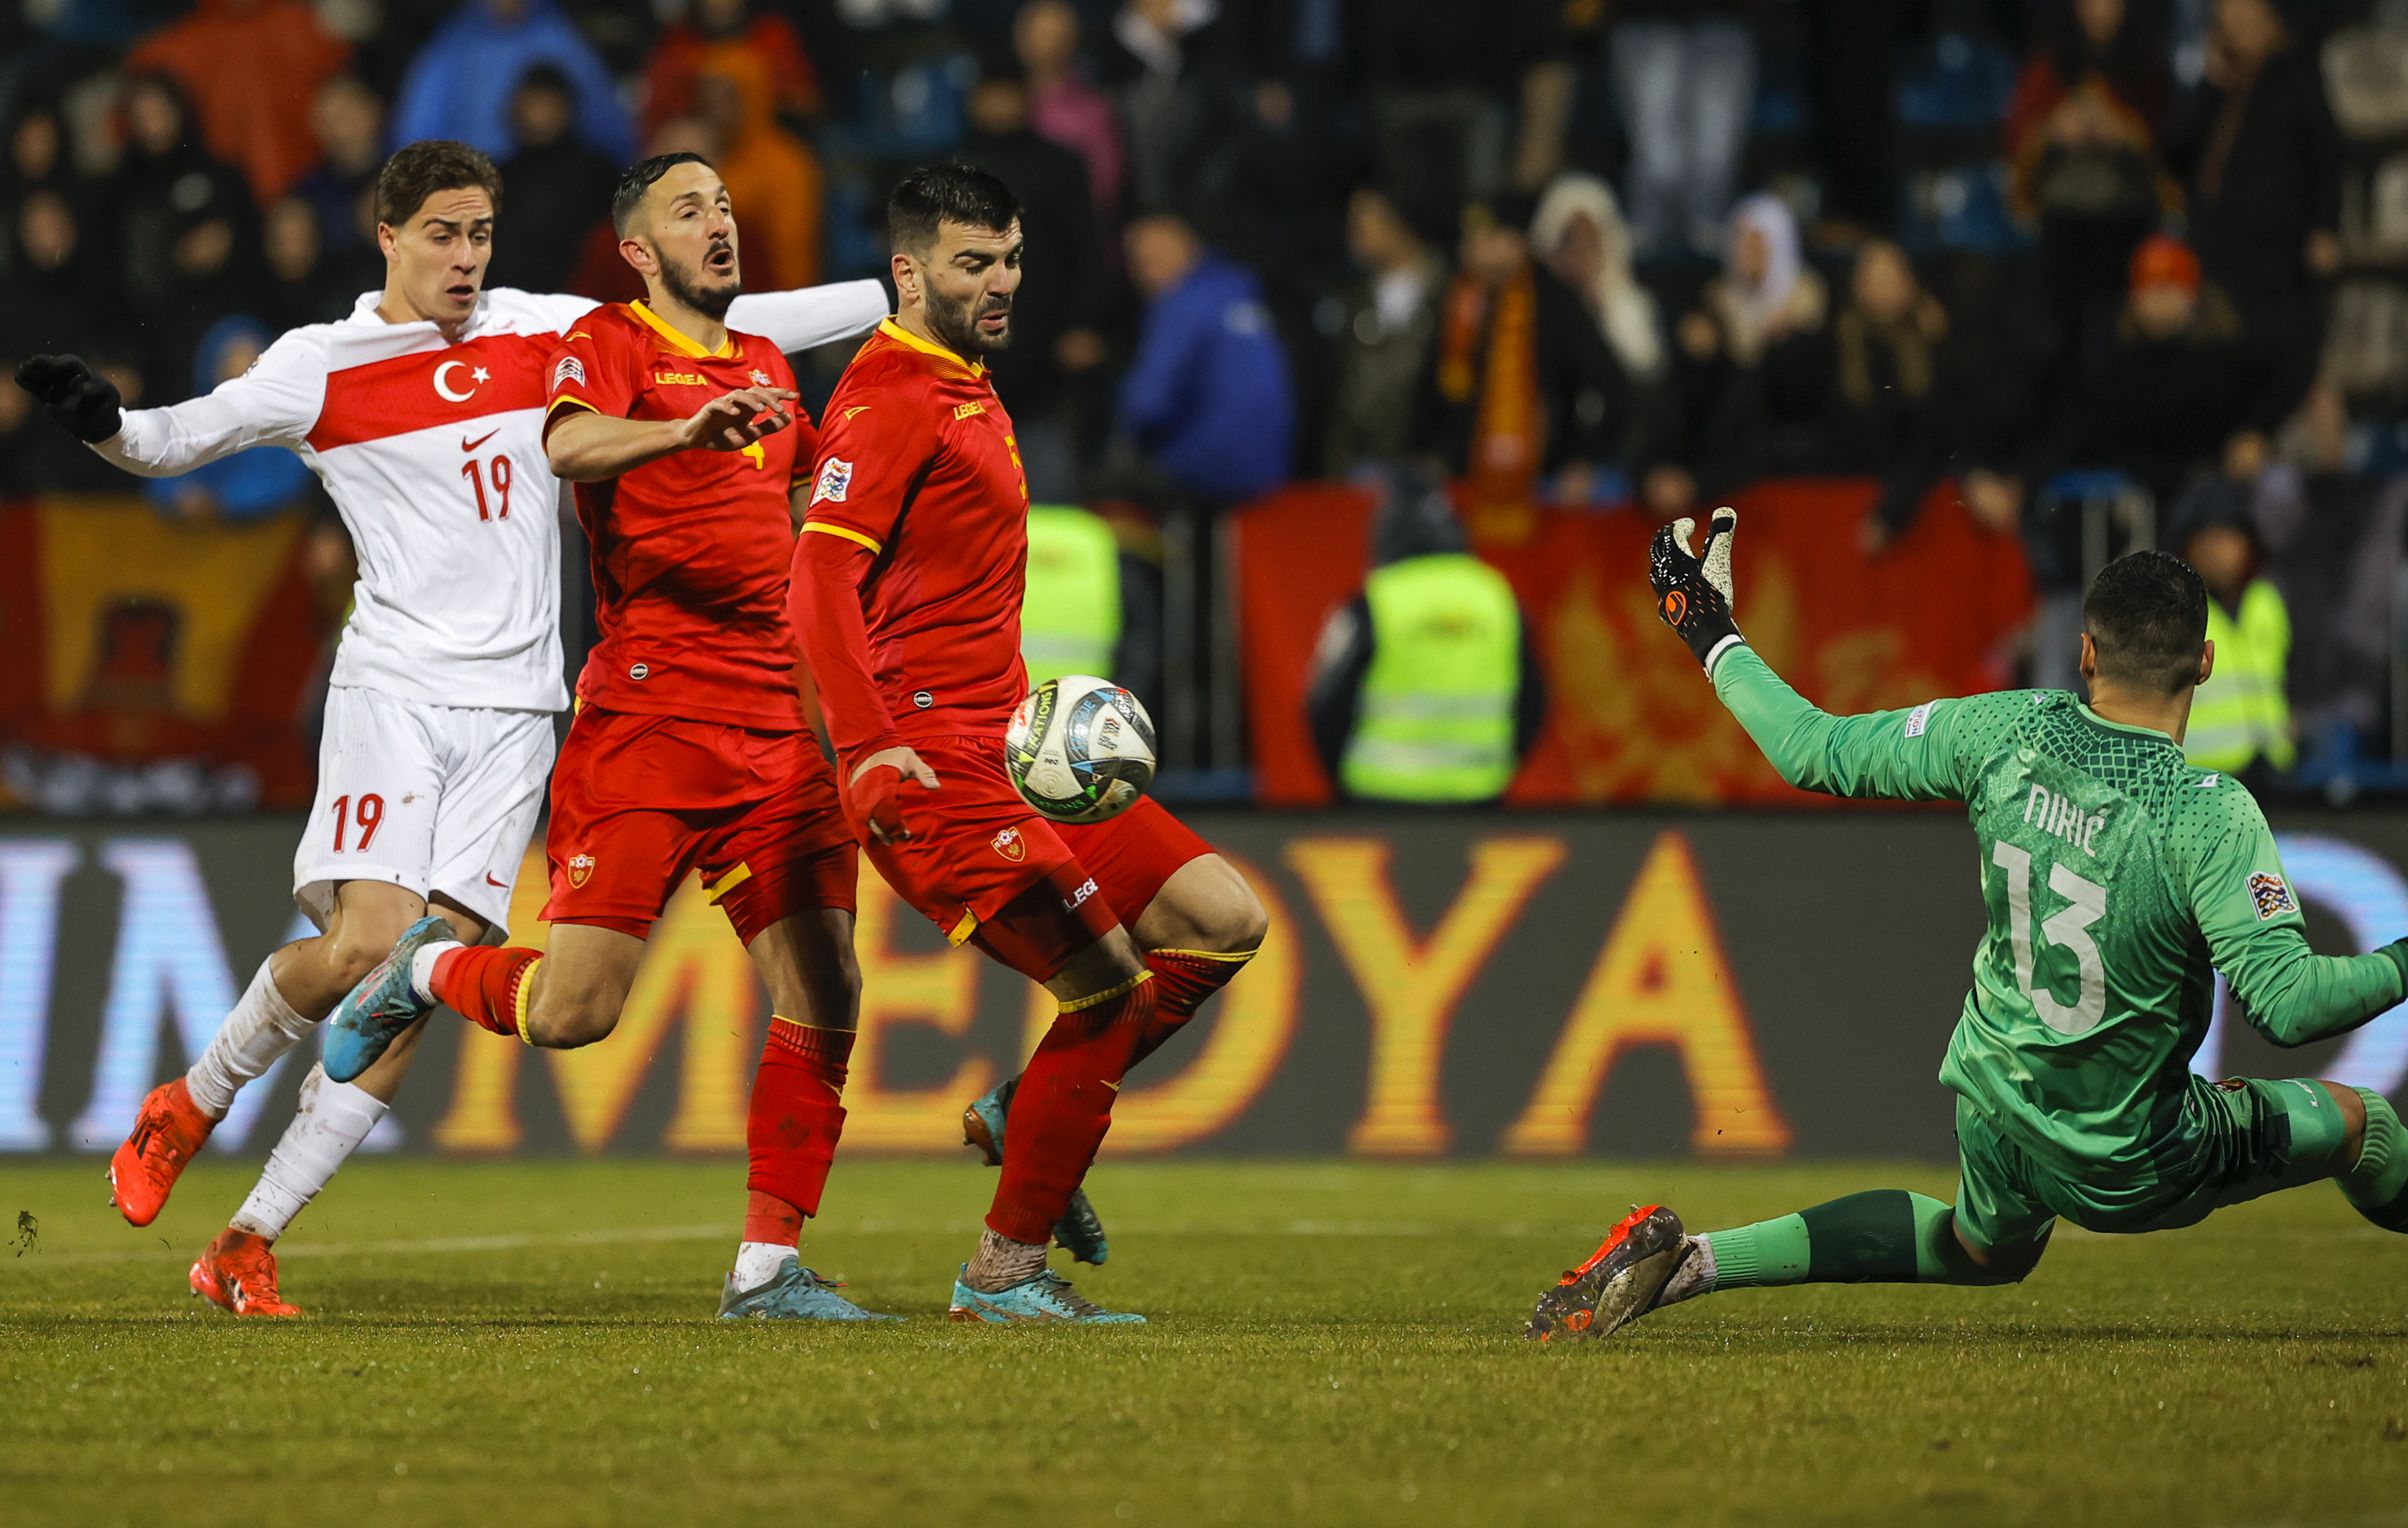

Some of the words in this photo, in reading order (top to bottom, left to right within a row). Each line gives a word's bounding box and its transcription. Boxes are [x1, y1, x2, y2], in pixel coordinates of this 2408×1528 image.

[654, 372, 708, 386] LEGEA
[461, 454, 513, 523] 19
[1071, 699, 1097, 750] LEGUE
[331, 792, 386, 854] 19
[1992, 839, 2107, 1036] 13
